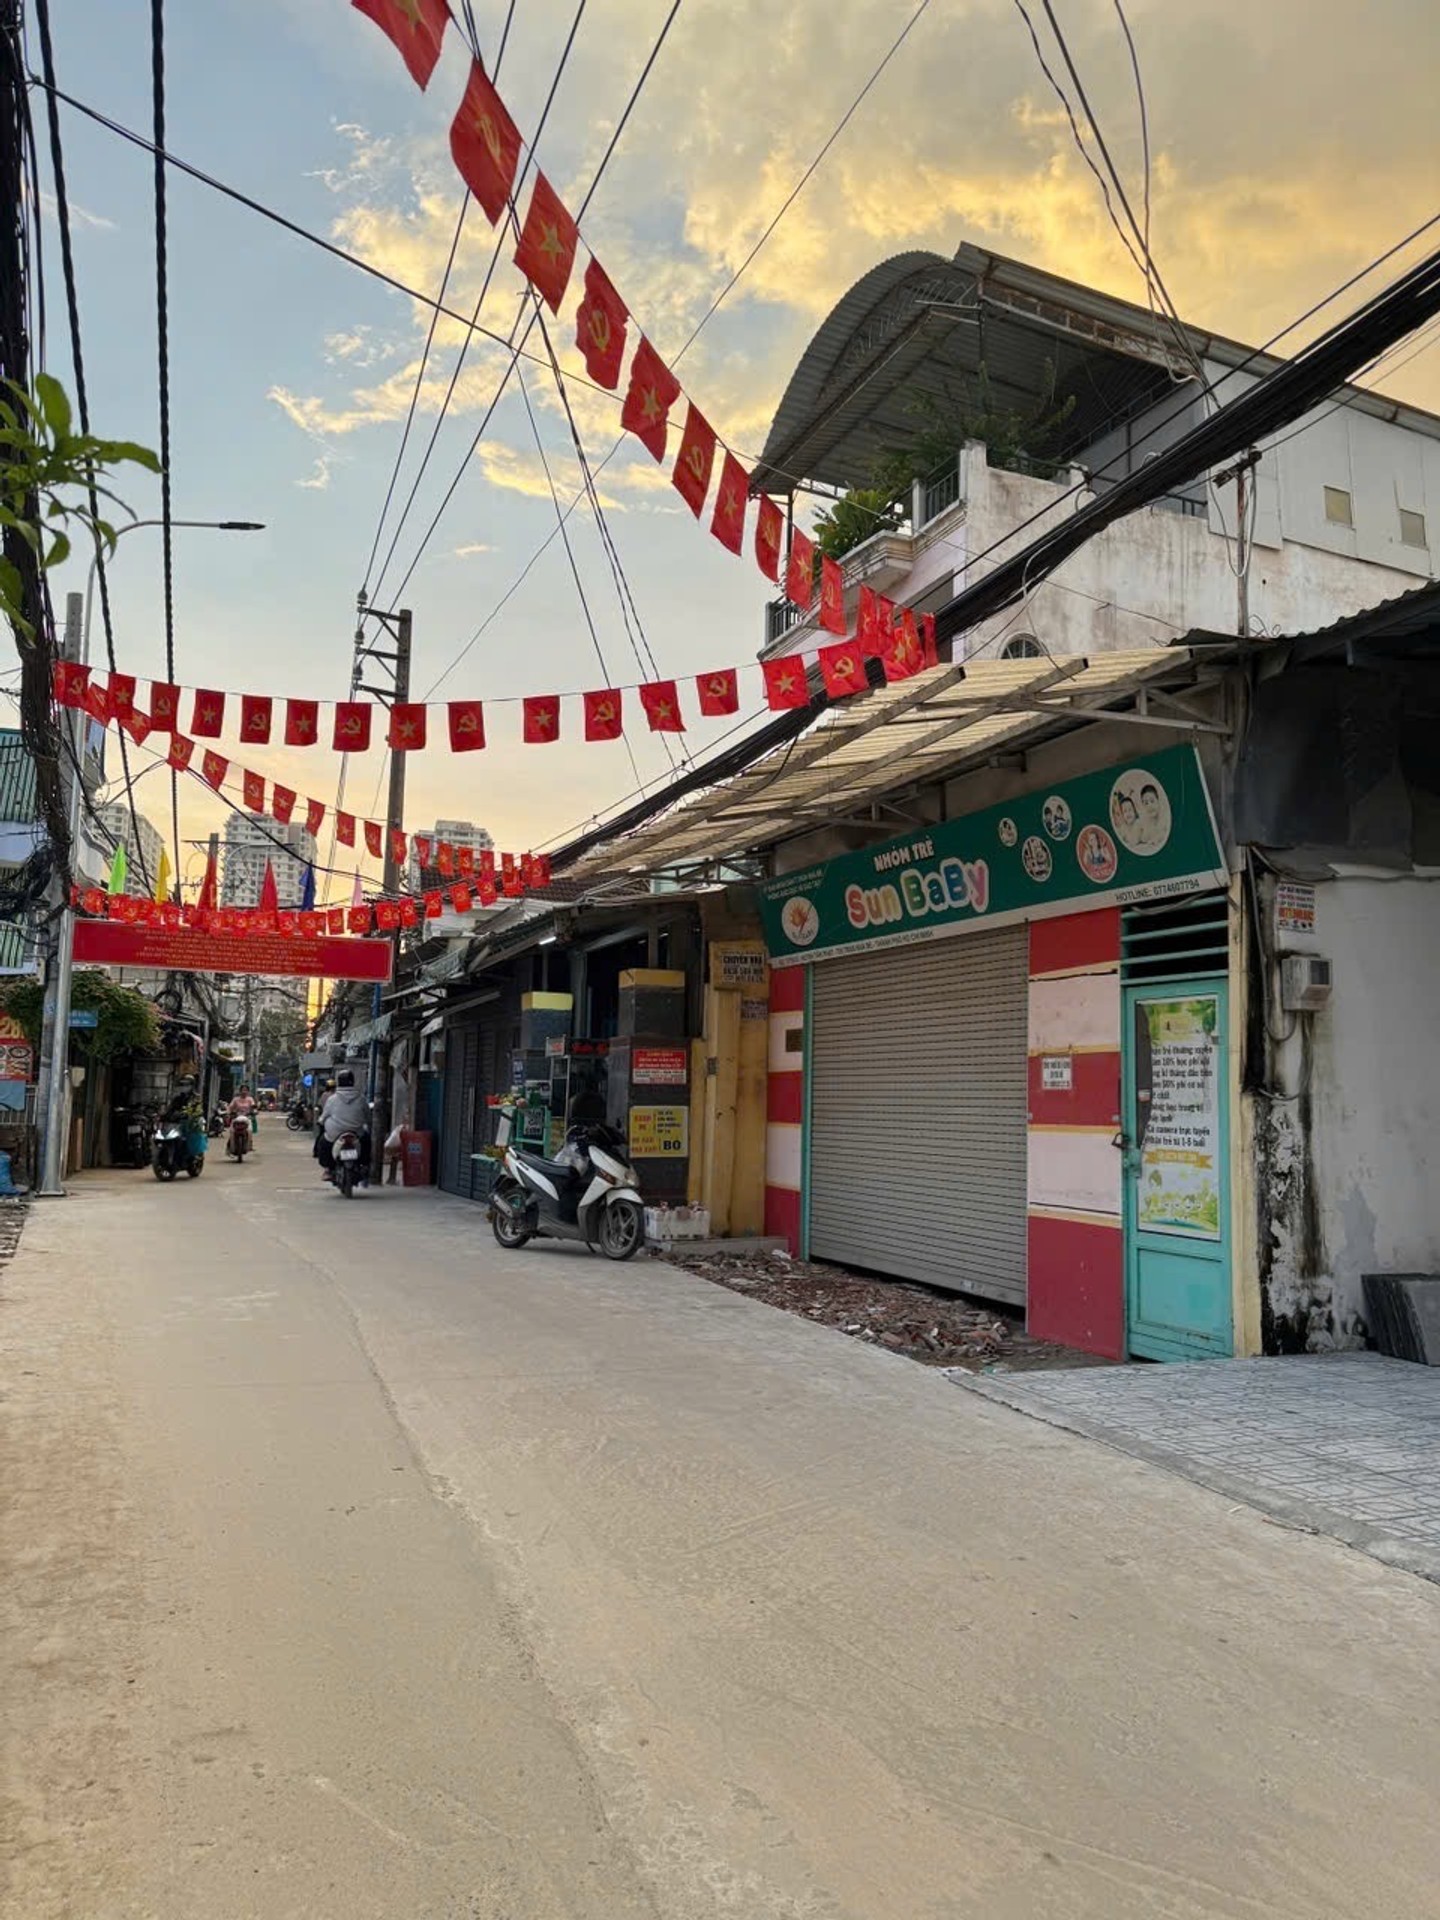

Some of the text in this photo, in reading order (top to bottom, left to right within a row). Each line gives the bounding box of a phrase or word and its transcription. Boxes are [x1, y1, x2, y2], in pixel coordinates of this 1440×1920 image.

[873, 845, 911, 871] NHÓM
[846, 885, 902, 927] Sun
[1114, 887, 1152, 902] HOTLINE:
